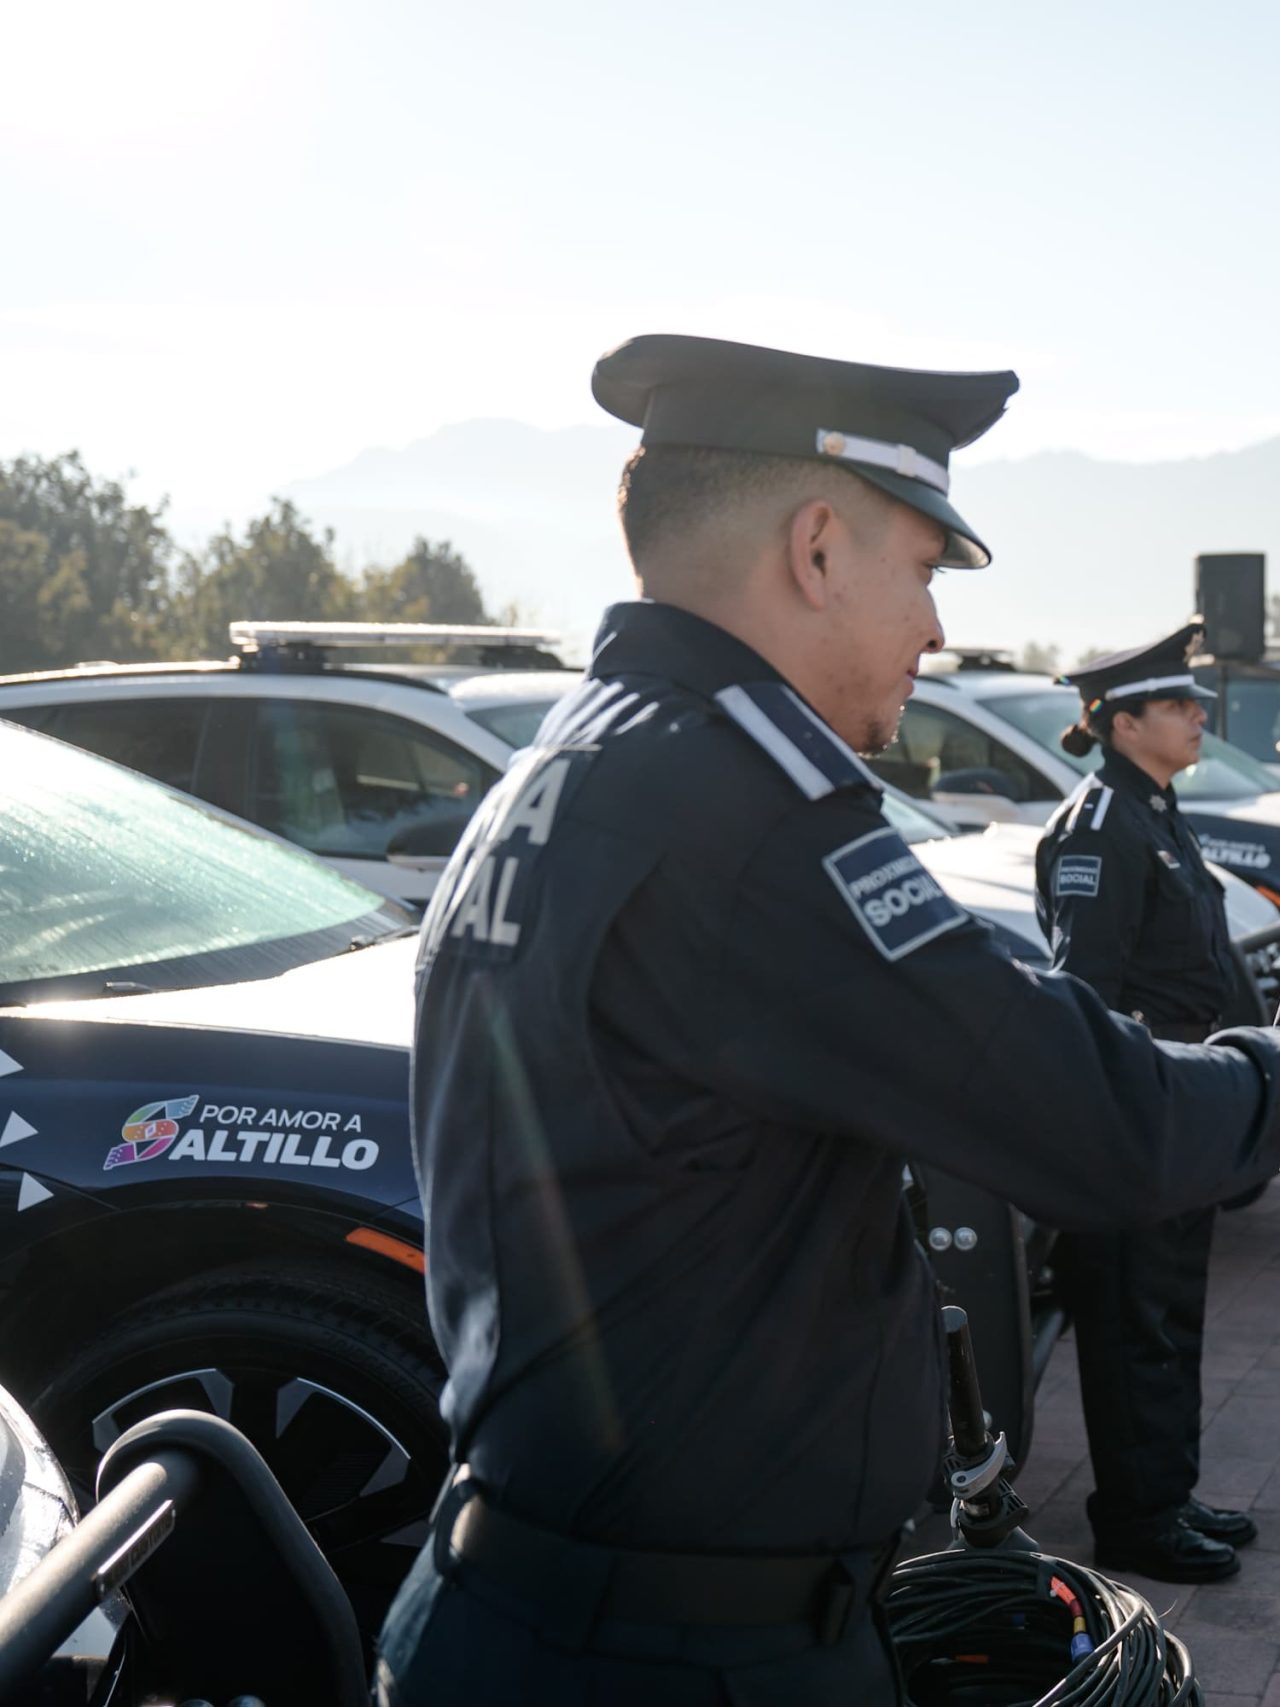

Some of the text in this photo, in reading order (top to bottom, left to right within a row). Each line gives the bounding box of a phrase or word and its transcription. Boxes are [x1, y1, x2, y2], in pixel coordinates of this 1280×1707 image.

[199, 1104, 362, 1132] POR AMOR A
